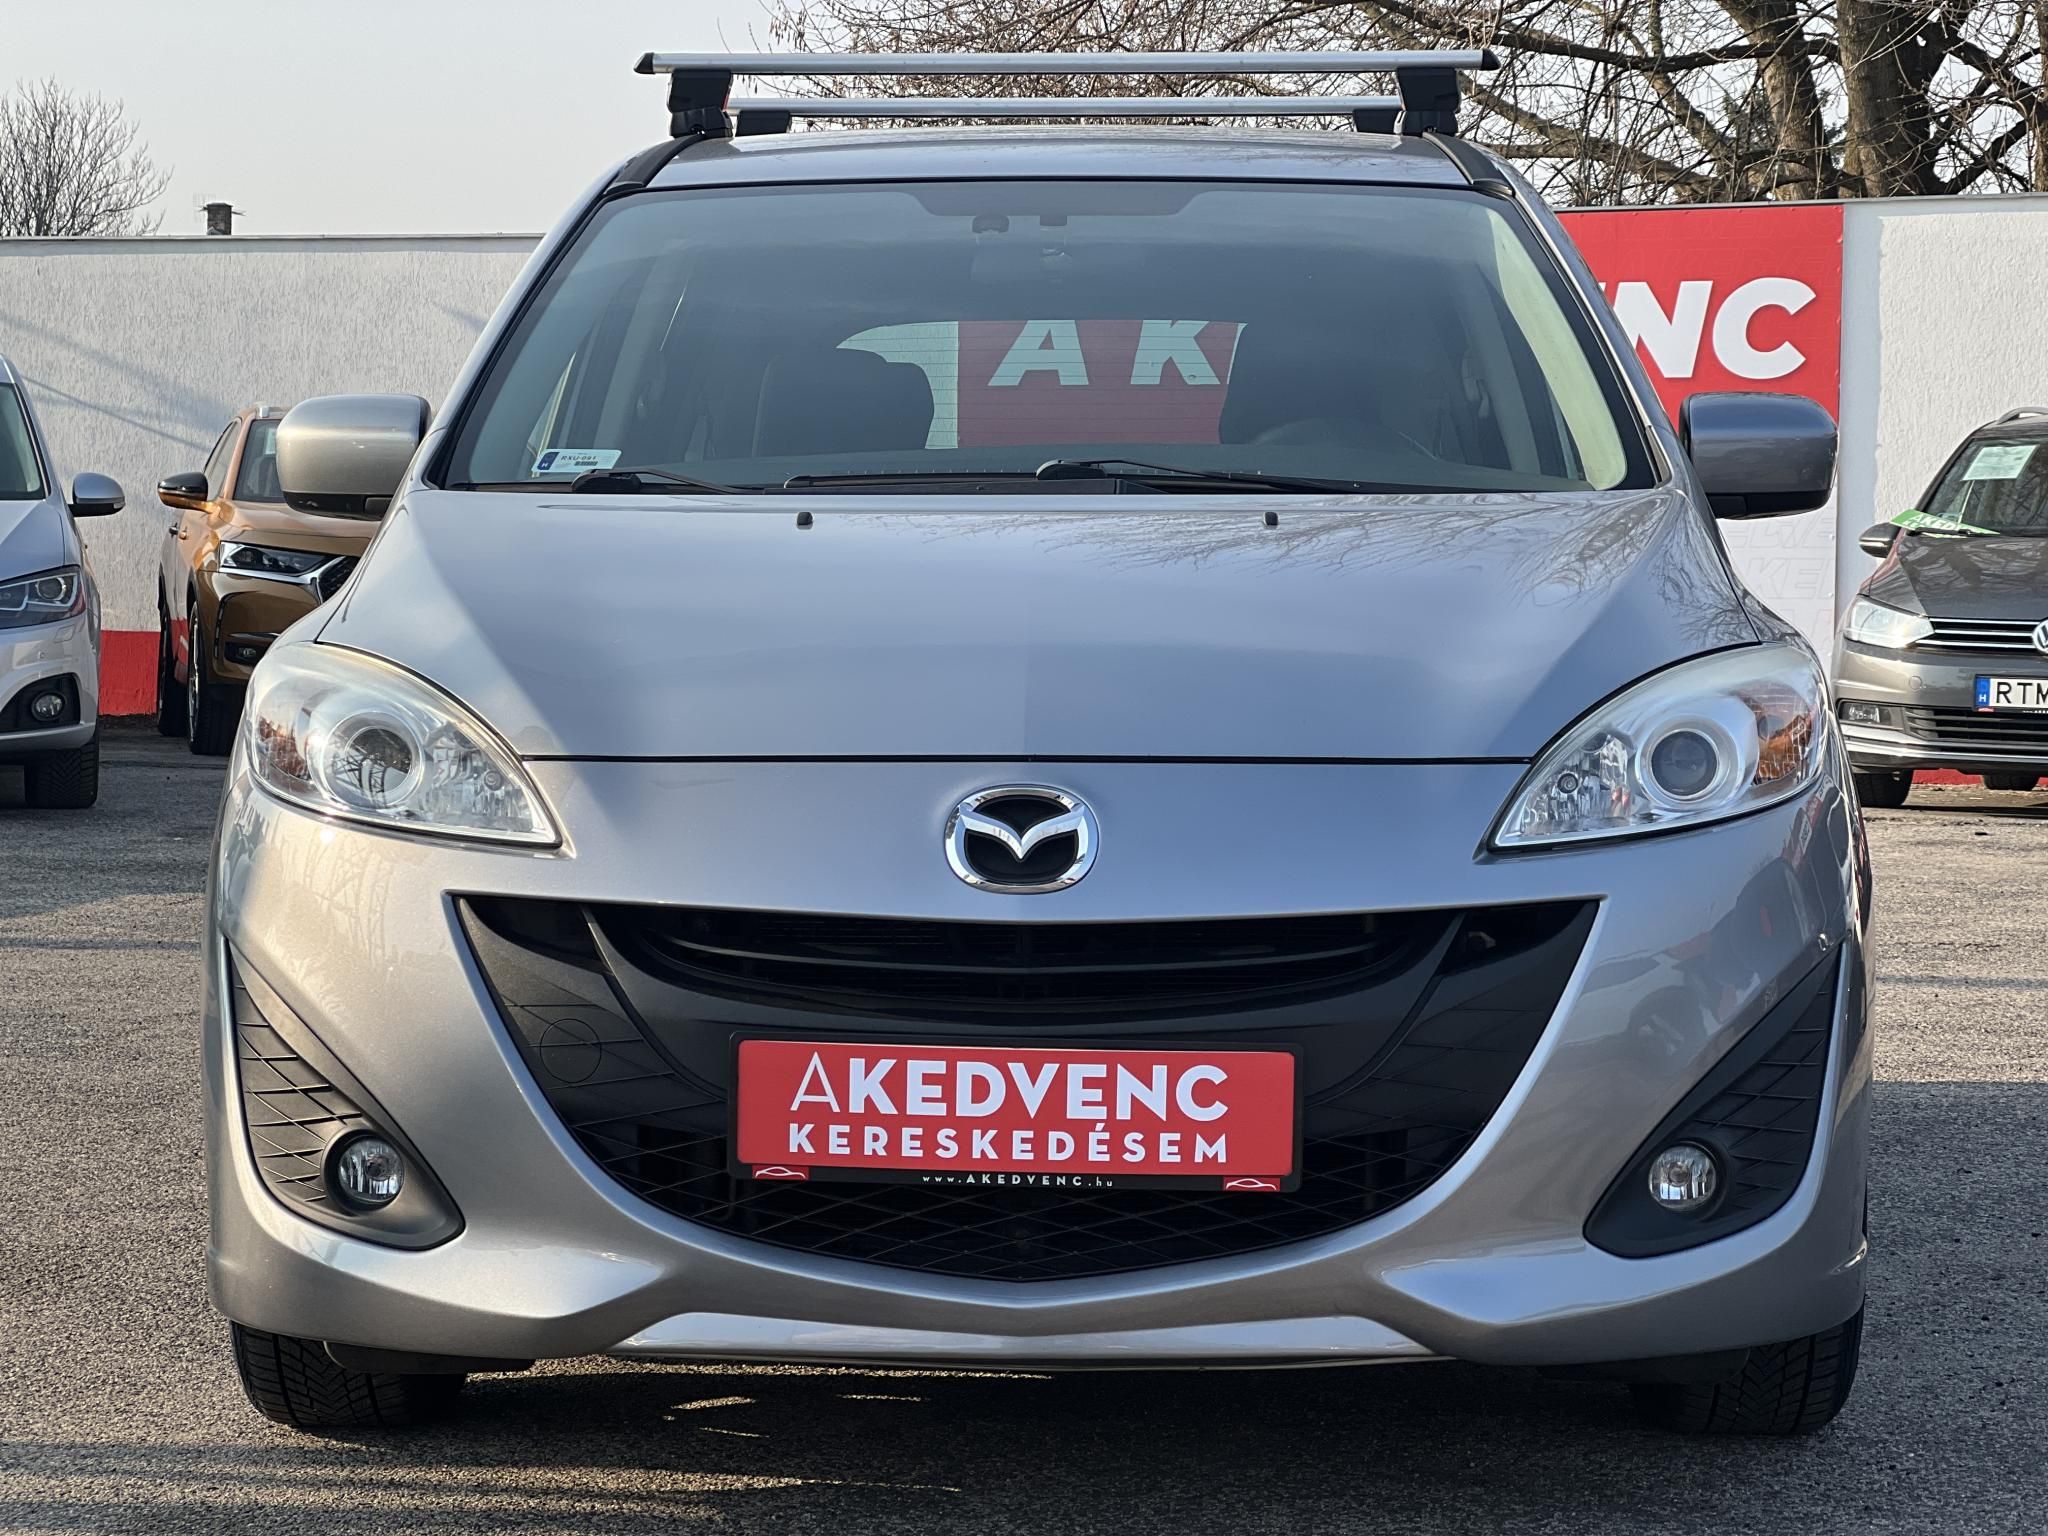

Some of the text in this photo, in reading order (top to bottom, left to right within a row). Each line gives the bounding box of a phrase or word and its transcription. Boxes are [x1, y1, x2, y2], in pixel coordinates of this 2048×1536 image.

[1599, 277, 1816, 379] NC
[1979, 694, 1987, 703] H
[790, 1051, 1228, 1121] AKEDVENC
[789, 1122, 1227, 1163] KERESKEDÉSEM
[922, 1173, 1113, 1188] www.AKEDVENC.hu
